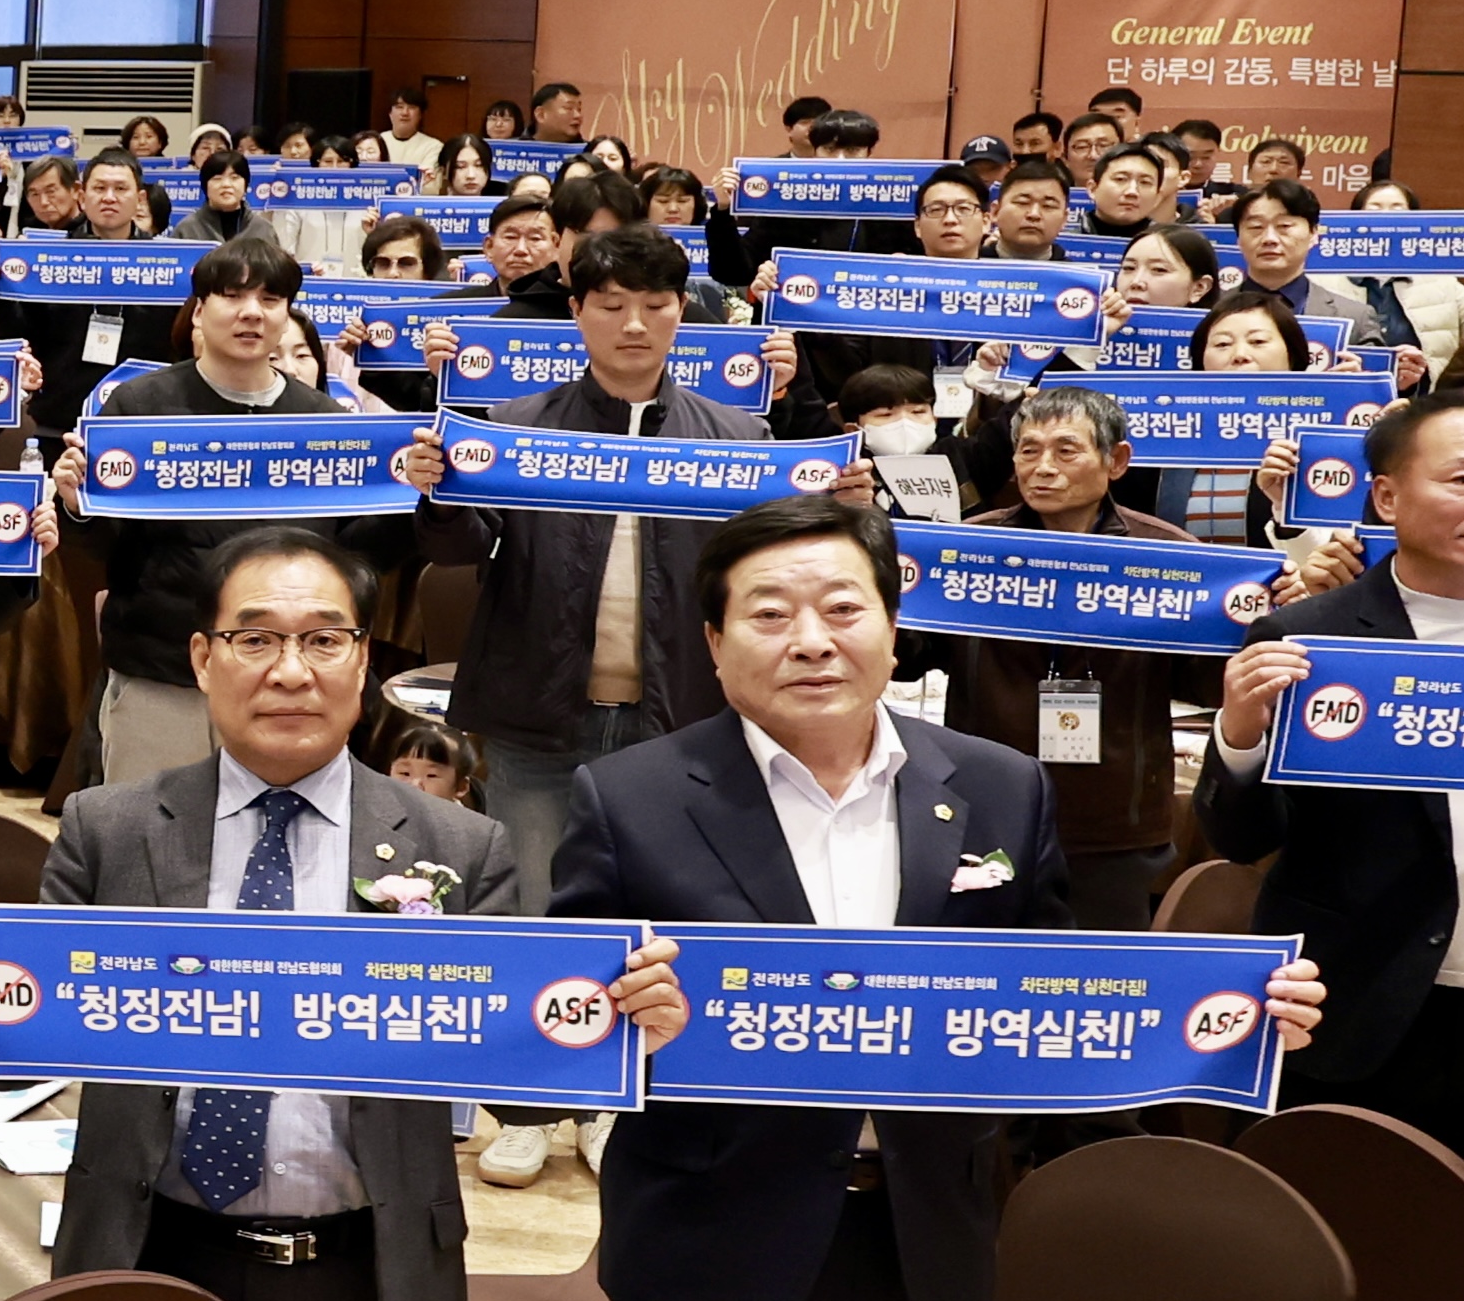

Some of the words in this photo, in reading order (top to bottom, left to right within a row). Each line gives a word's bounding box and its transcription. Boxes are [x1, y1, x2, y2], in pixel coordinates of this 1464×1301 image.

[1110, 17, 1226, 46] General
[1229, 17, 1314, 46] Event
[1107, 56, 1133, 84] 단
[1140, 56, 1216, 86] 하루의
[1224, 56, 1279, 87] 감동,
[1288, 57, 1364, 87] 특별한
[1372, 58, 1398, 88] 날
[31, 264, 102, 285] “청정전남!
[110, 259, 184, 286] 방역실천!”
[824, 280, 928, 315] “청정전남!
[939, 288, 1046, 321] 방역실천!”
[144, 459, 252, 489] “청정전남!
[267, 455, 378, 488] 방역실천!”
[504, 446, 629, 486] “청정전남!
[646, 458, 778, 493] 방역실천!”
[897, 476, 954, 499] 해남지부
[929, 568, 1056, 610] “청정전남!
[1075, 583, 1211, 622] 방역실천!”
[1230, 594, 1265, 612] ASF
[99, 956, 158, 972] 전라남도
[209, 959, 275, 974] 대한한돈협회
[276, 961, 343, 976] 전남도협의회
[365, 962, 424, 981] 차단방역
[427, 964, 492, 983] 실천다짐!
[751, 972, 811, 988] 전라남도
[56, 982, 260, 1038] “청정전남!
[294, 992, 508, 1044] 방역실천!”
[544, 997, 600, 1025] ASF
[705, 999, 913, 1056] “청정전남!
[945, 1007, 1161, 1060] 방역실천!”
[1195, 1012, 1255, 1043] ASF
